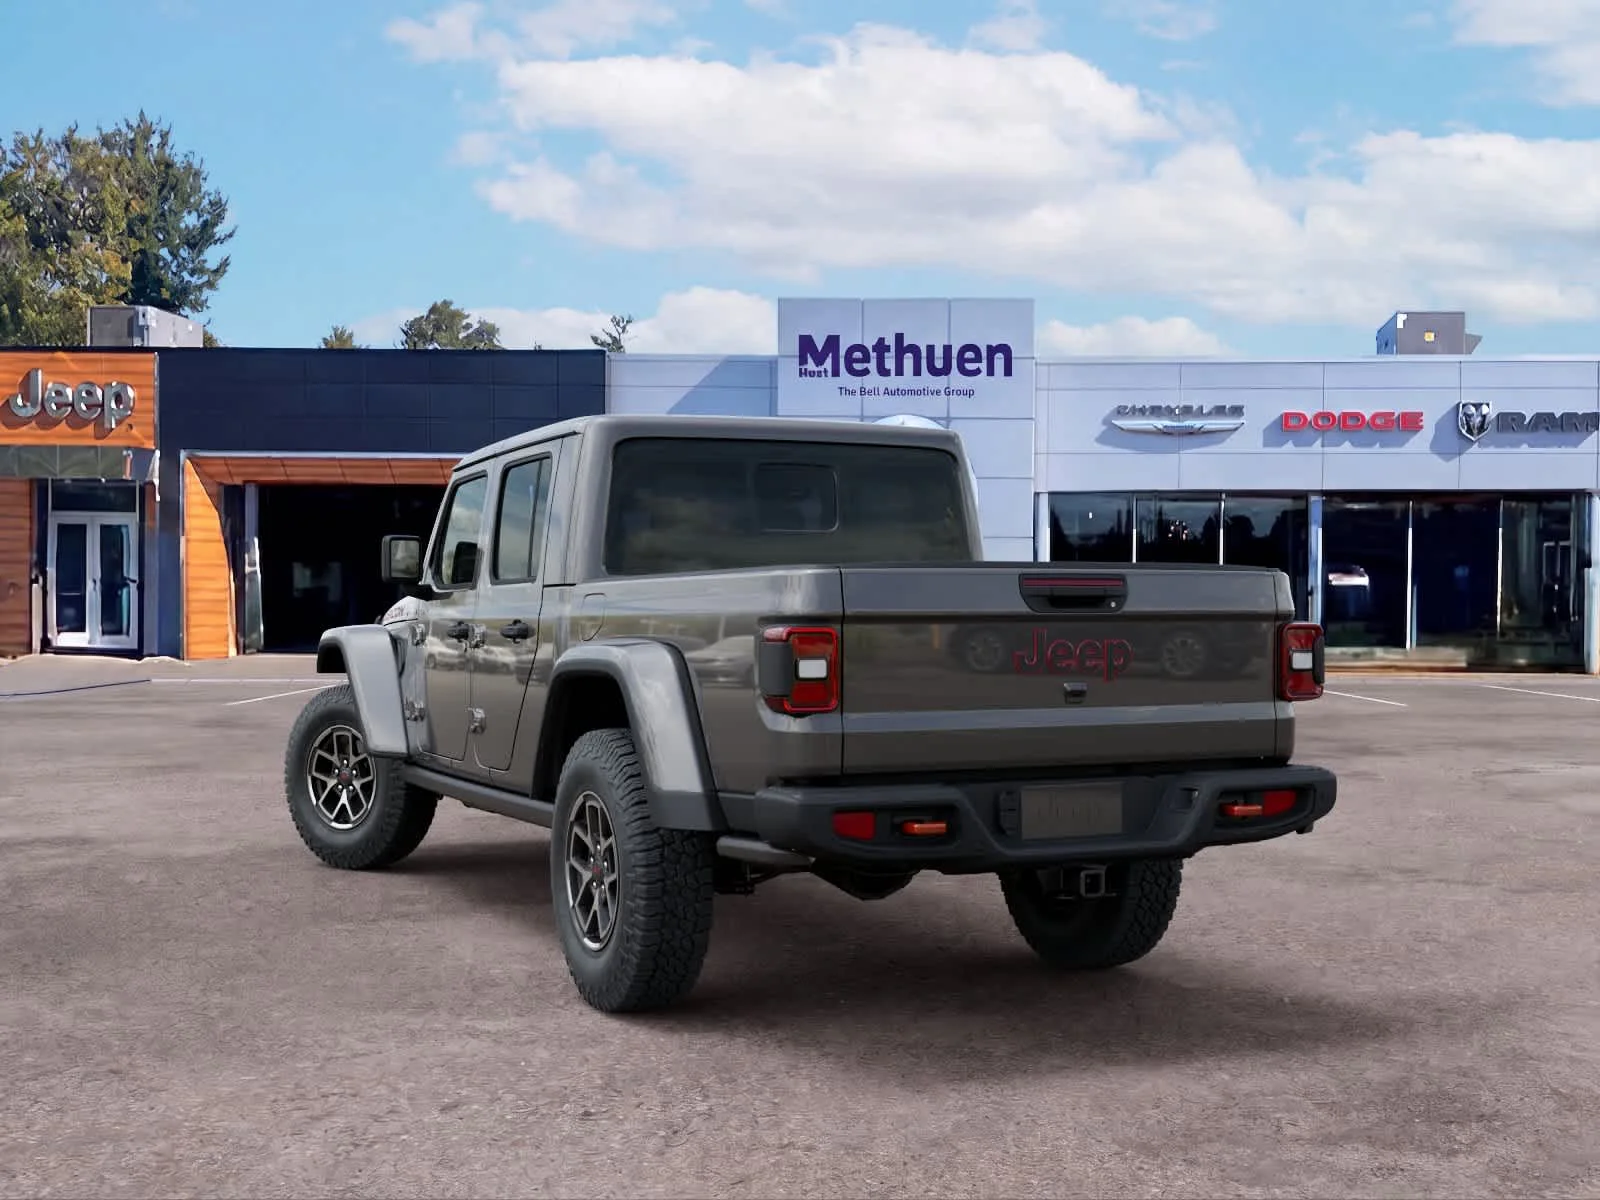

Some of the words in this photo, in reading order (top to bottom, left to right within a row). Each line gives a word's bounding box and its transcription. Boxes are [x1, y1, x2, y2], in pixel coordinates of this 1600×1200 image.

[798, 333, 1013, 377] Methuen
[9, 368, 135, 429] Jeep
[838, 387, 856, 396] The
[860, 387, 880, 396] Bell
[883, 386, 941, 396] Automotive
[944, 387, 975, 398] Group
[1282, 410, 1424, 431] DODGE
[1497, 411, 1600, 432] RAM
[1013, 627, 1133, 682] Jeep
